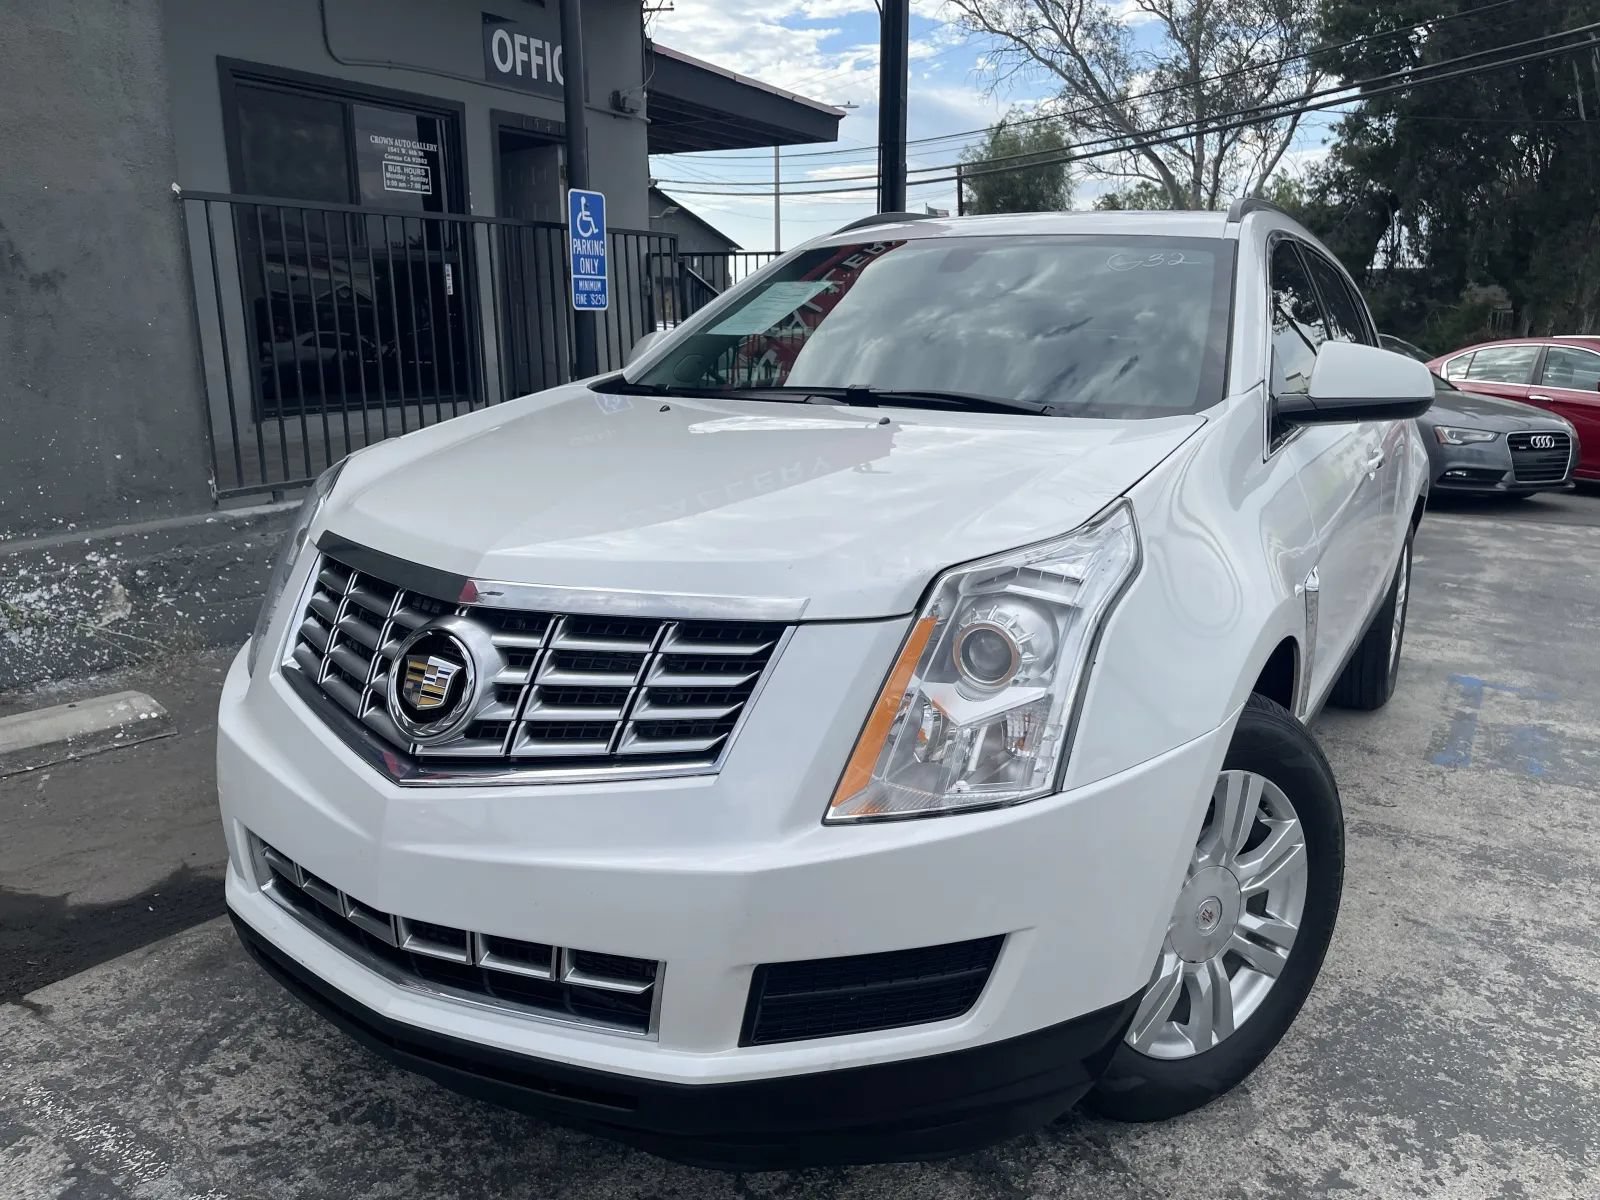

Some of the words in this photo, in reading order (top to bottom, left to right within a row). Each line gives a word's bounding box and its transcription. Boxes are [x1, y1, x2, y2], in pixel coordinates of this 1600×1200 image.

[370, 135, 393, 145] CROWN
[395, 139, 411, 148] AUTO
[412, 141, 437, 151] GALLERY
[404, 167, 425, 175] HOURS
[386, 172, 406, 181] Monday
[410, 175, 428, 183] Sunday
[573, 238, 604, 256] PARKING
[580, 257, 599, 274] ONLY
[578, 280, 602, 292] MINIMUM
[576, 293, 588, 305] FINE
[590, 293, 606, 305] $250
